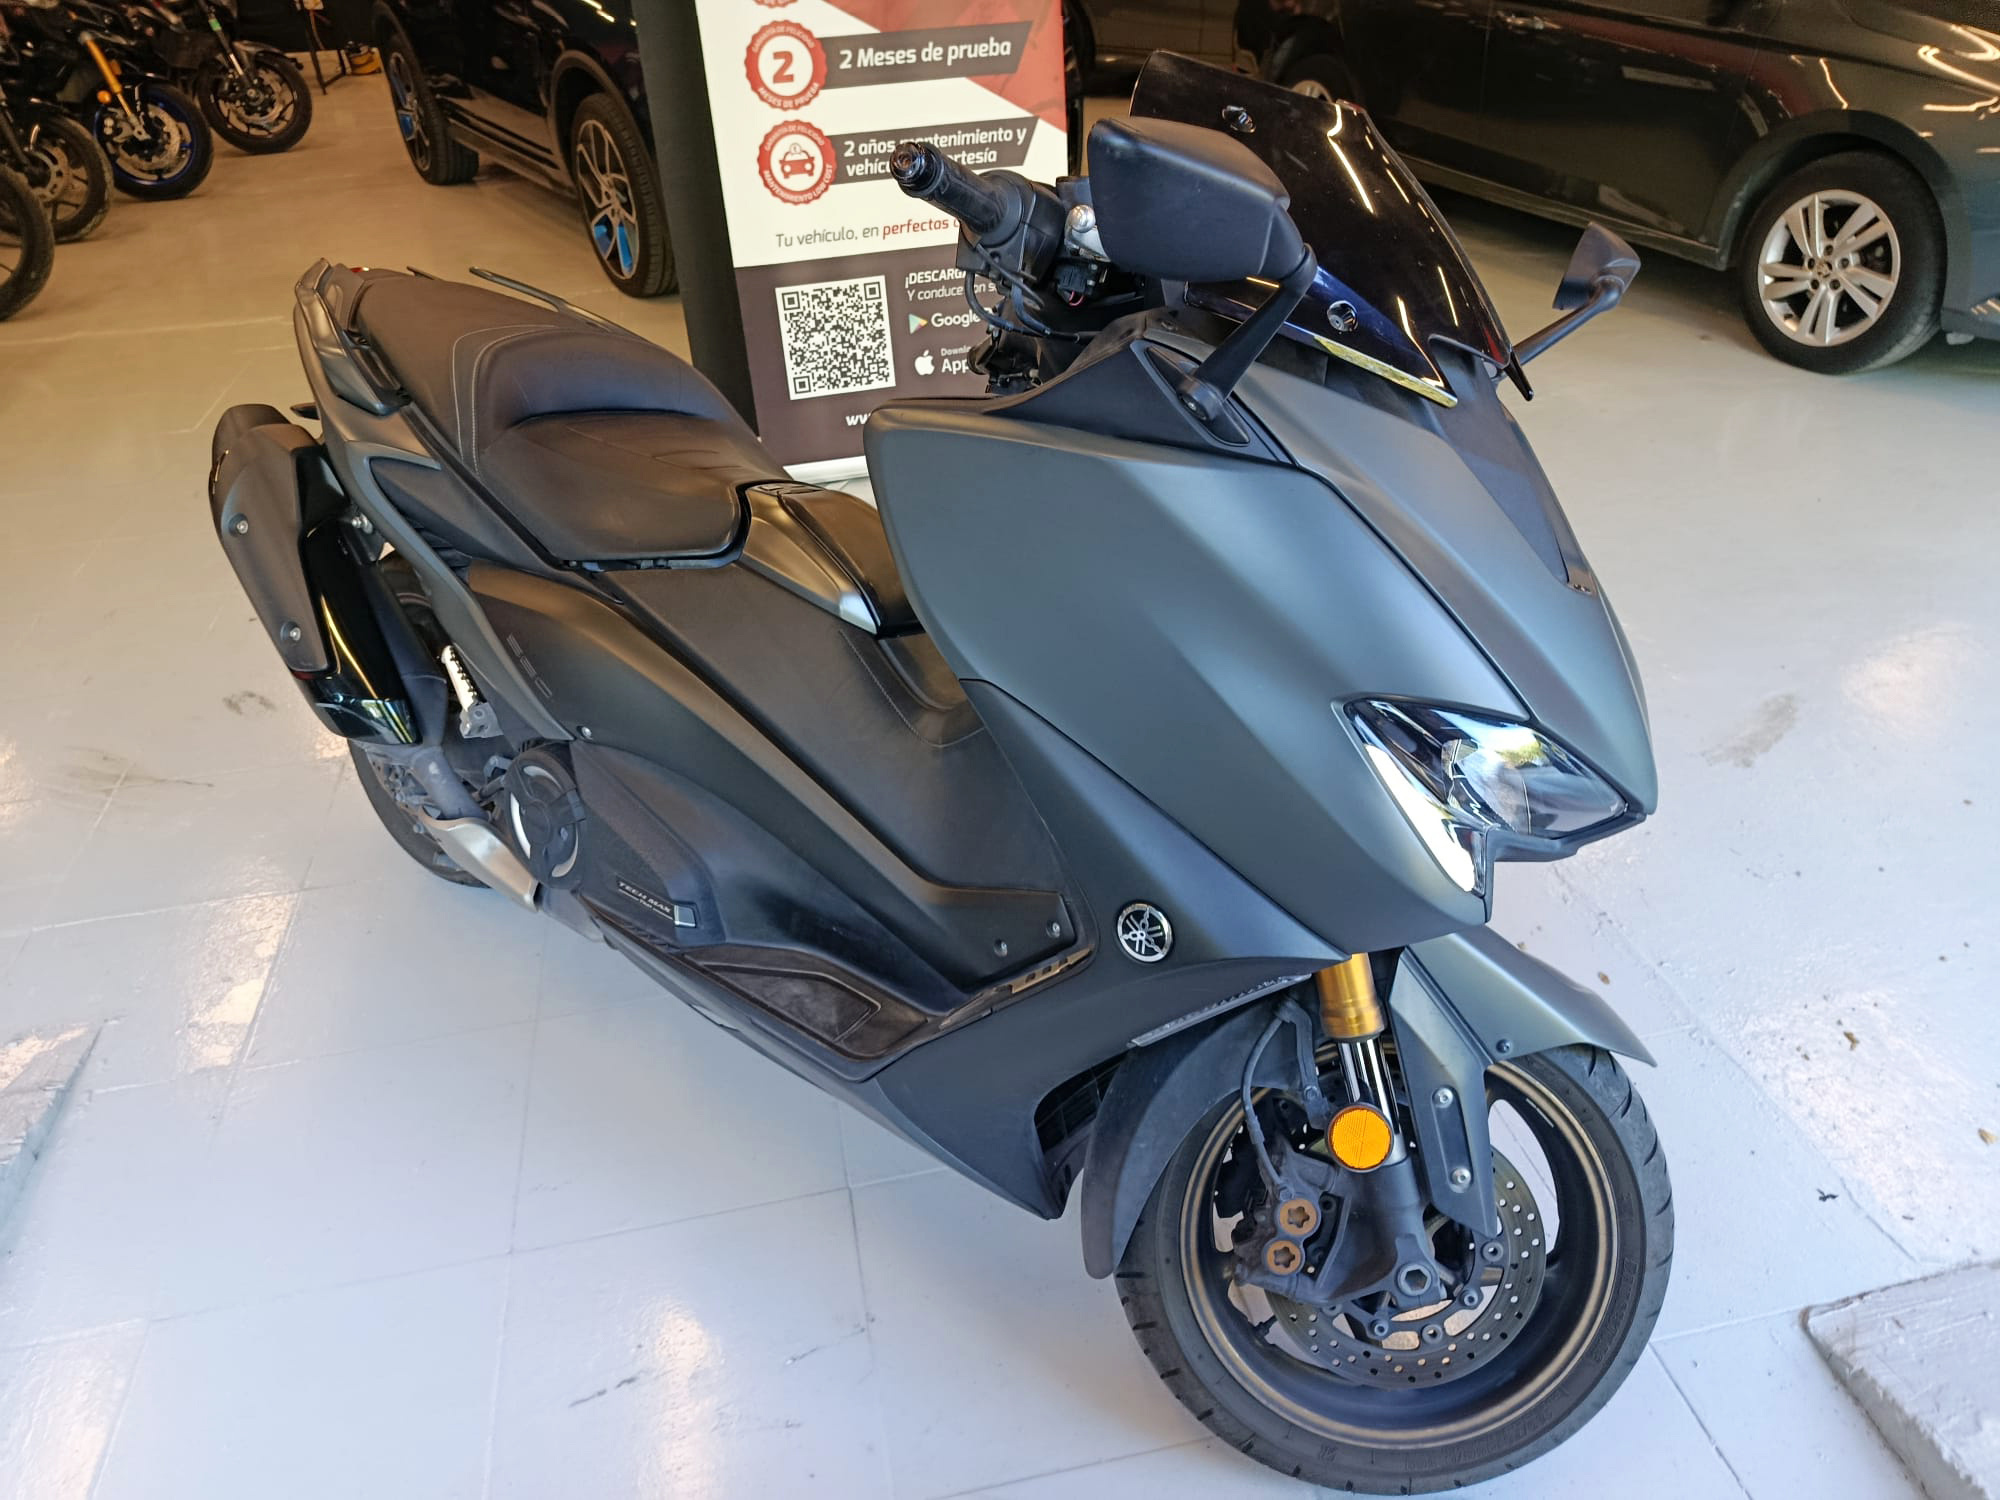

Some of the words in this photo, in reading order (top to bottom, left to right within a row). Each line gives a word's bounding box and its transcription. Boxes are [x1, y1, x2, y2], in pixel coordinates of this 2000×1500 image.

[773, 50, 794, 84] 2
[839, 50, 852, 69] 2
[857, 47, 917, 68] Meses
[921, 41, 943, 62] de
[947, 36, 1012, 66] prueba
[843, 140, 855, 157] 2
[858, 139, 896, 156] años
[1016, 128, 1028, 146] y
[776, 233, 793, 247] Tu
[797, 226, 858, 246] vehículo,
[862, 225, 879, 239] en
[883, 218, 949, 240] perfectas
[907, 289, 915, 301] Y
[917, 285, 964, 301] conduce
[931, 308, 981, 328] Google
